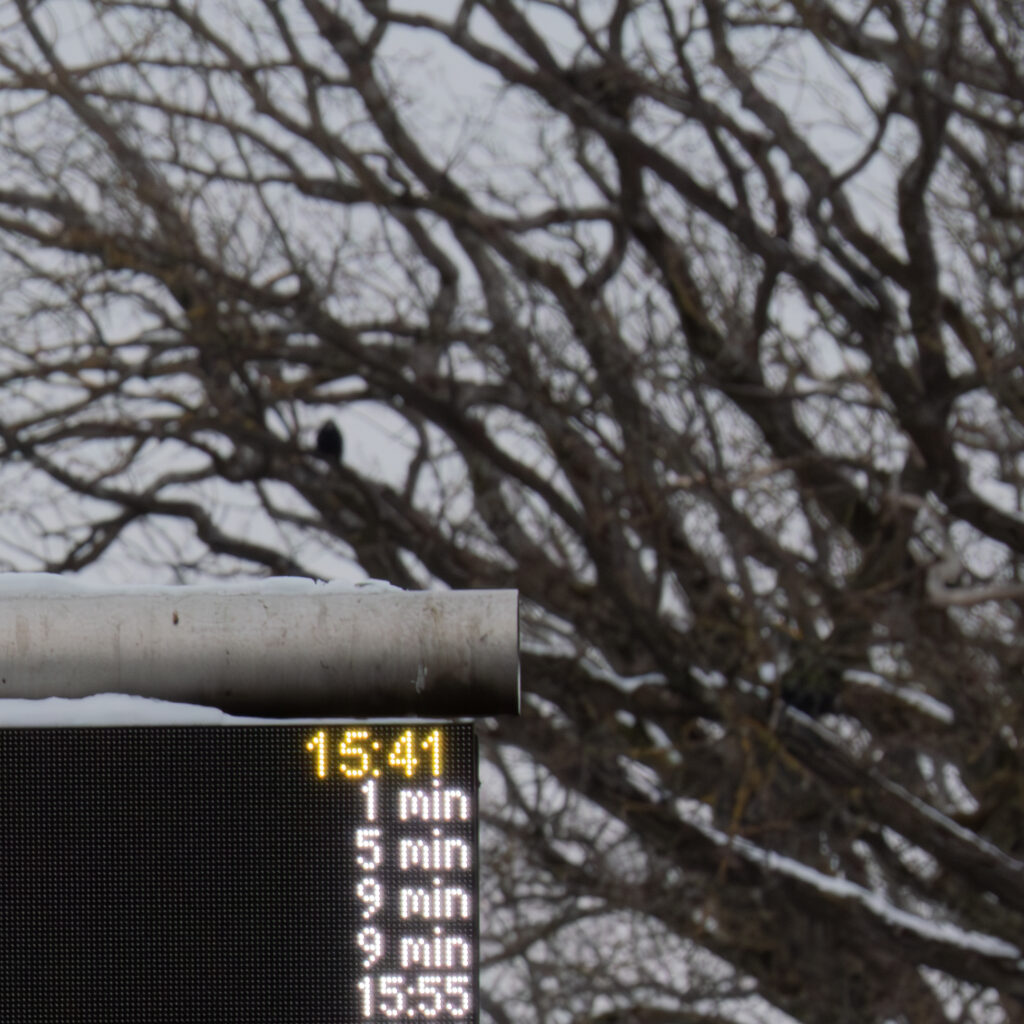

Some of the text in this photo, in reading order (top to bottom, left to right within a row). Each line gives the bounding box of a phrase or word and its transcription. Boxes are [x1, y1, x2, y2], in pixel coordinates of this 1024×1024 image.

[307, 730, 442, 778] 15:41
[361, 779, 375, 821] 1
[398, 779, 468, 821] min
[356, 828, 381, 870] 5
[399, 828, 469, 870] min
[356, 877, 381, 919] 9
[399, 877, 469, 919] min
[356, 926, 381, 968] 9
[400, 926, 470, 968] min
[358, 976, 470, 1018] 15:55
